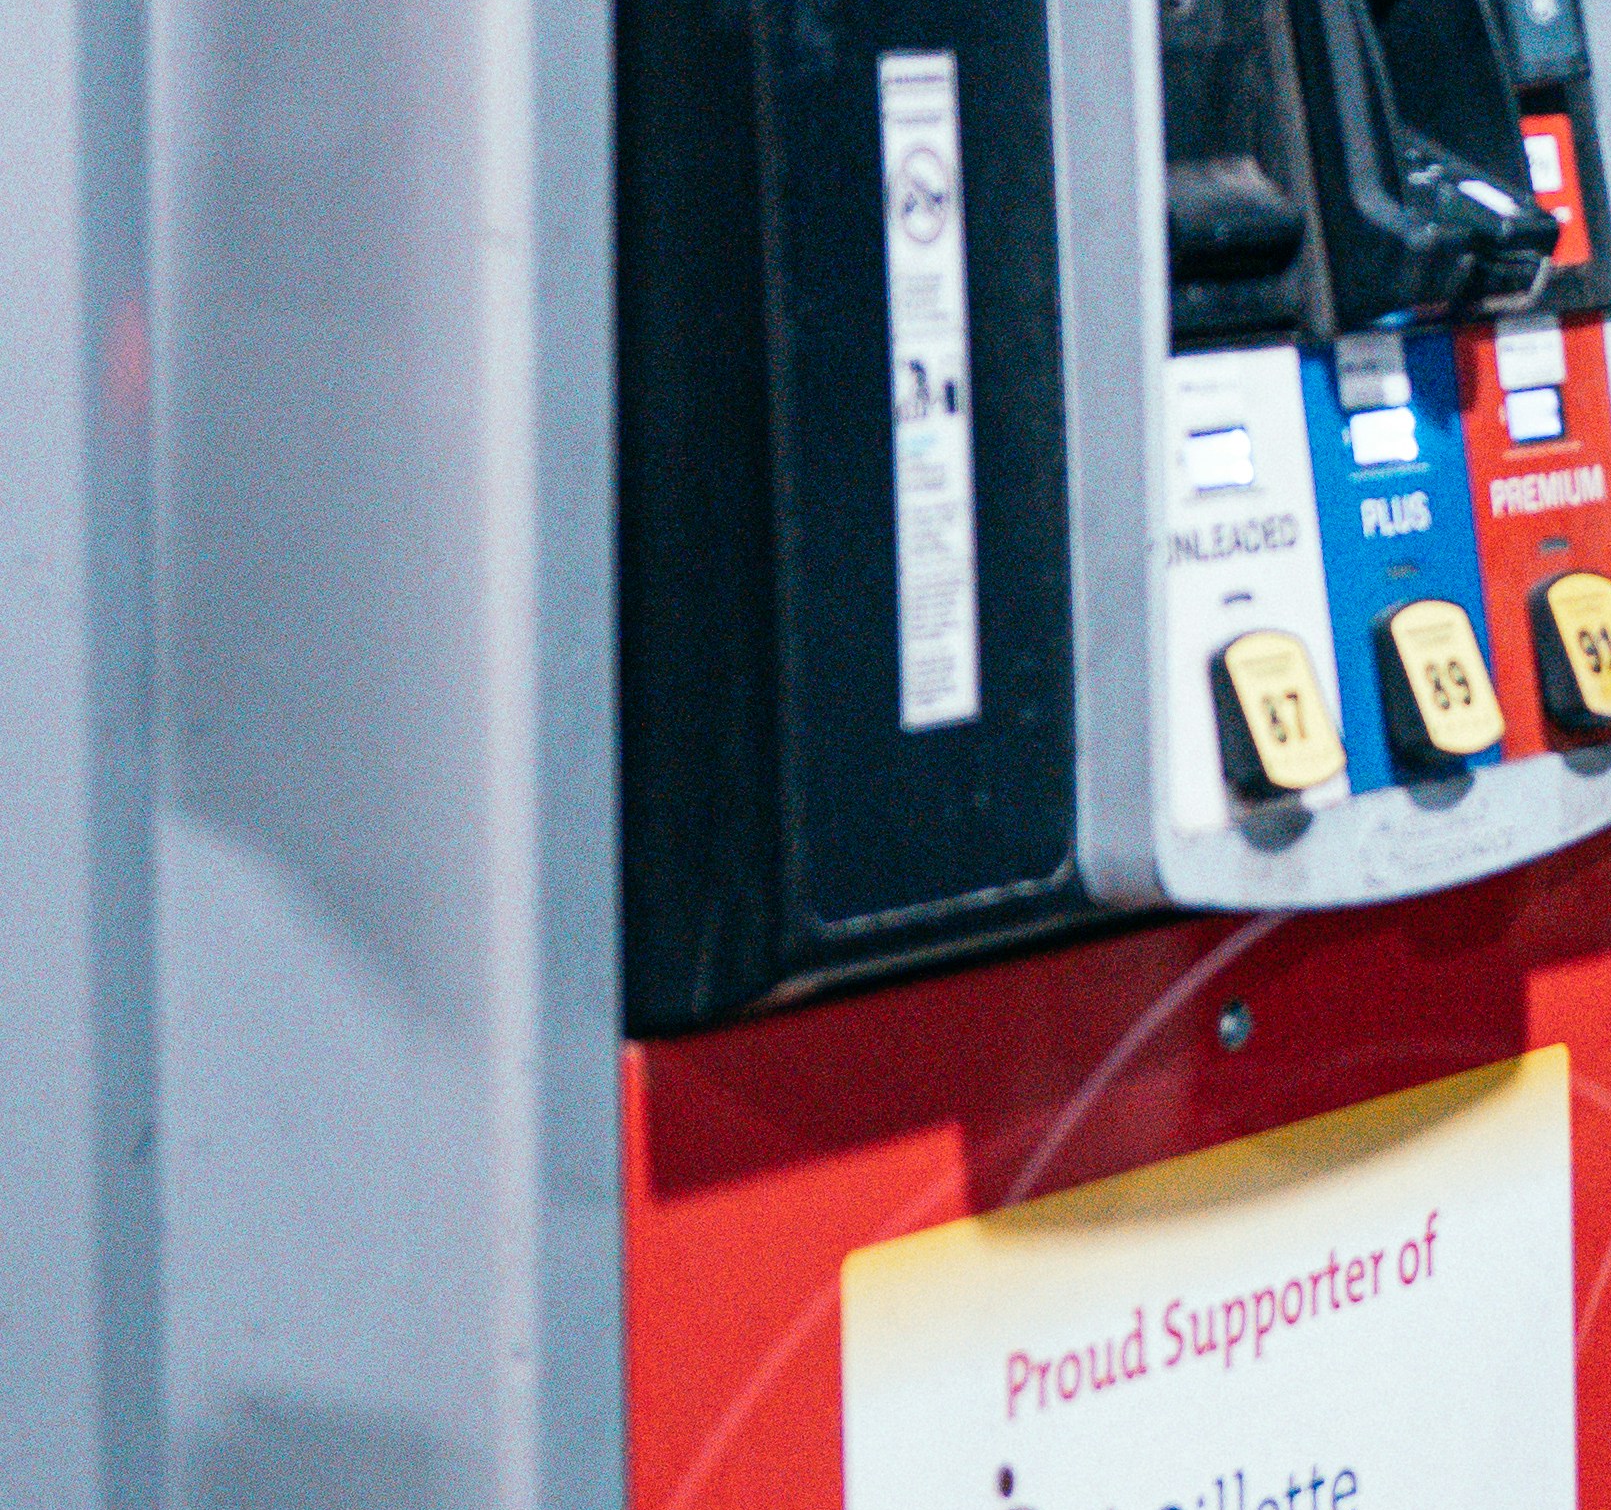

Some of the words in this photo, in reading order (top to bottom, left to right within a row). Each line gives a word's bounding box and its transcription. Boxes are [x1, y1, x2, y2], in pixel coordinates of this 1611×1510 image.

[1360, 490, 1434, 540] PLUS
[1489, 464, 1607, 518] PREMIUM
[1423, 659, 1473, 712] 89
[1006, 1306, 1149, 1420] Proud
[1163, 1249, 1385, 1370] Supporter
[1397, 1208, 1441, 1286] of
